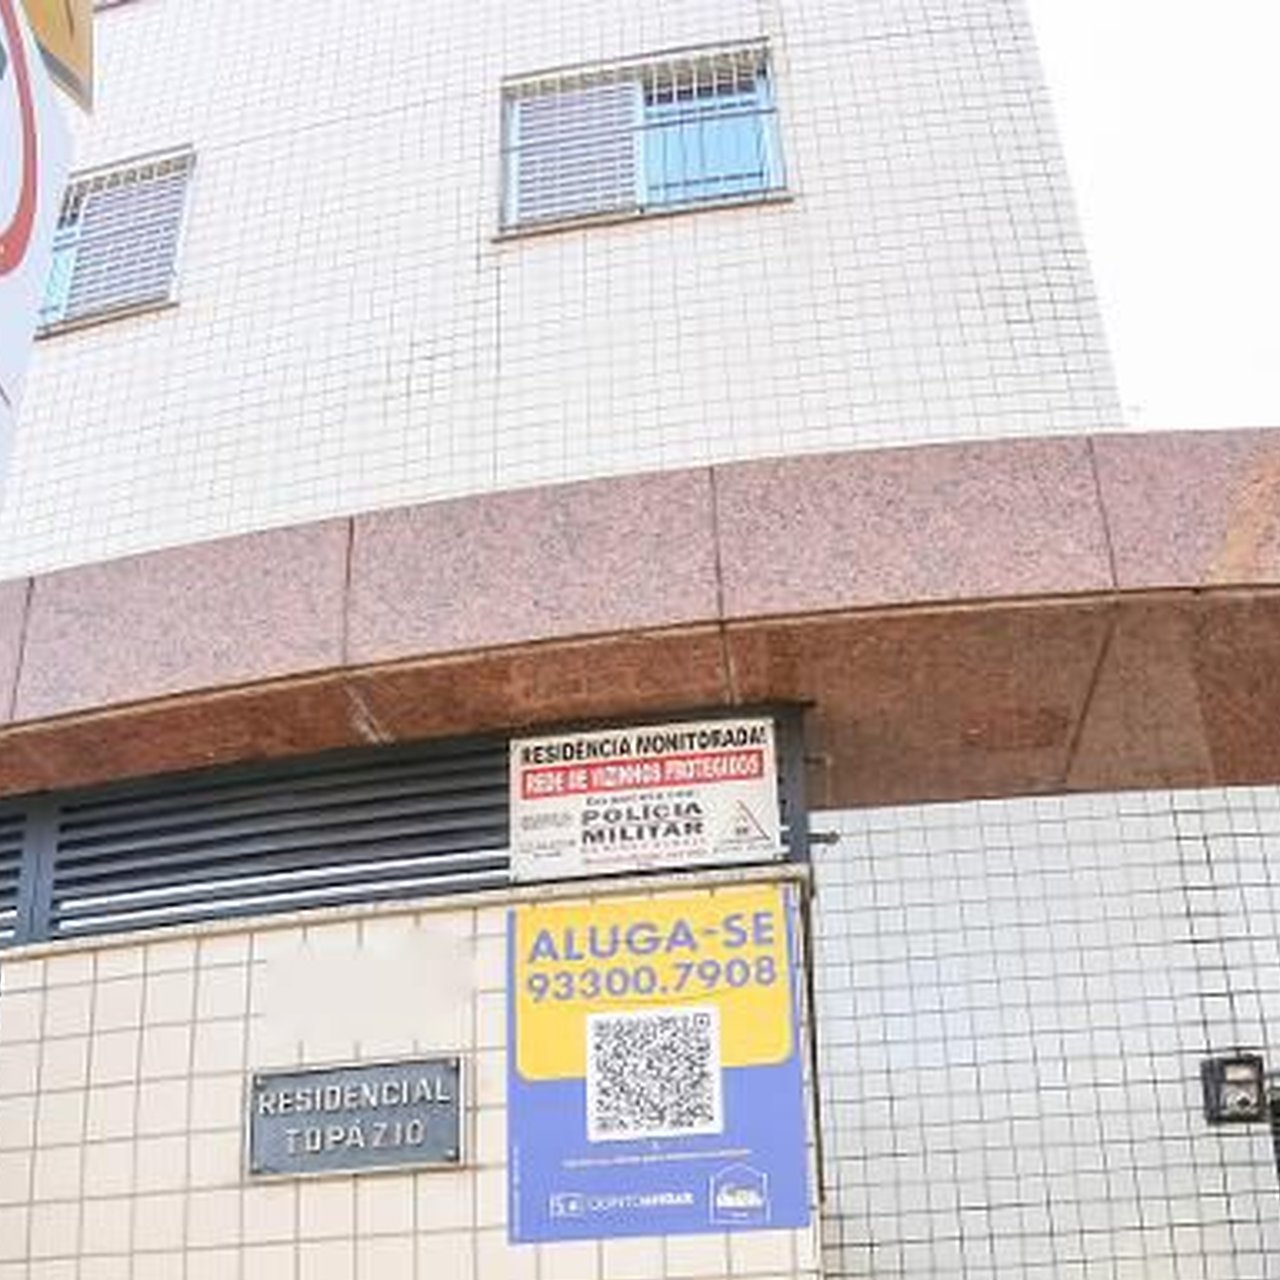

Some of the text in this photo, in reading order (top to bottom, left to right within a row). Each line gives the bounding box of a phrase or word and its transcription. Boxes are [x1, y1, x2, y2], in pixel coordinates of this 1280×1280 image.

[525, 770, 564, 794] REDE
[568, 769, 587, 788] DE
[581, 821, 704, 845] MILITAR
[528, 912, 775, 964] ALUGA-SE
[527, 957, 777, 1002] 93300.7908
[258, 1076, 451, 1116] RESIDENCIAL
